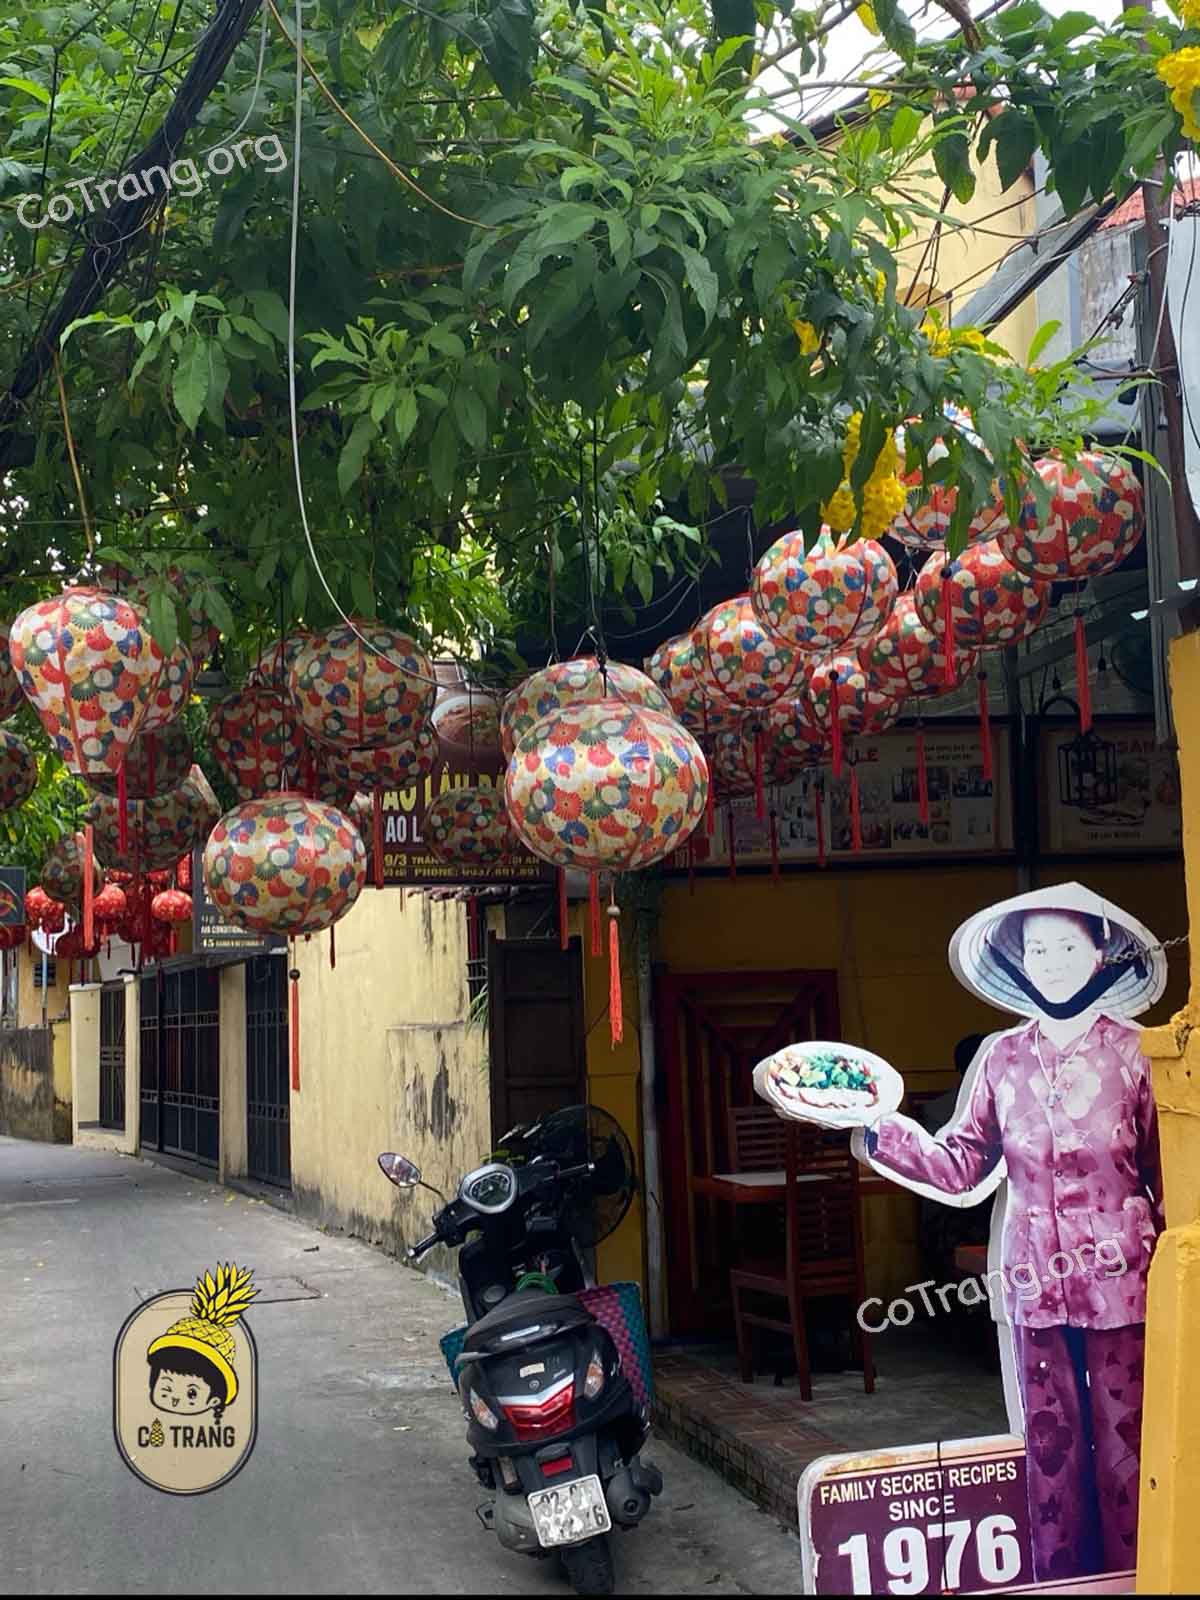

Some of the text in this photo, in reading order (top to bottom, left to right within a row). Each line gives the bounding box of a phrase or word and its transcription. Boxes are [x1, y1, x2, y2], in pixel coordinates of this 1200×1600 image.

[384, 815, 407, 843] AO
[820, 1461, 1017, 1505] FAMILY SECRET RECIPES
[889, 1494, 956, 1521] SINCE
[838, 1514, 1022, 1595] 1976
